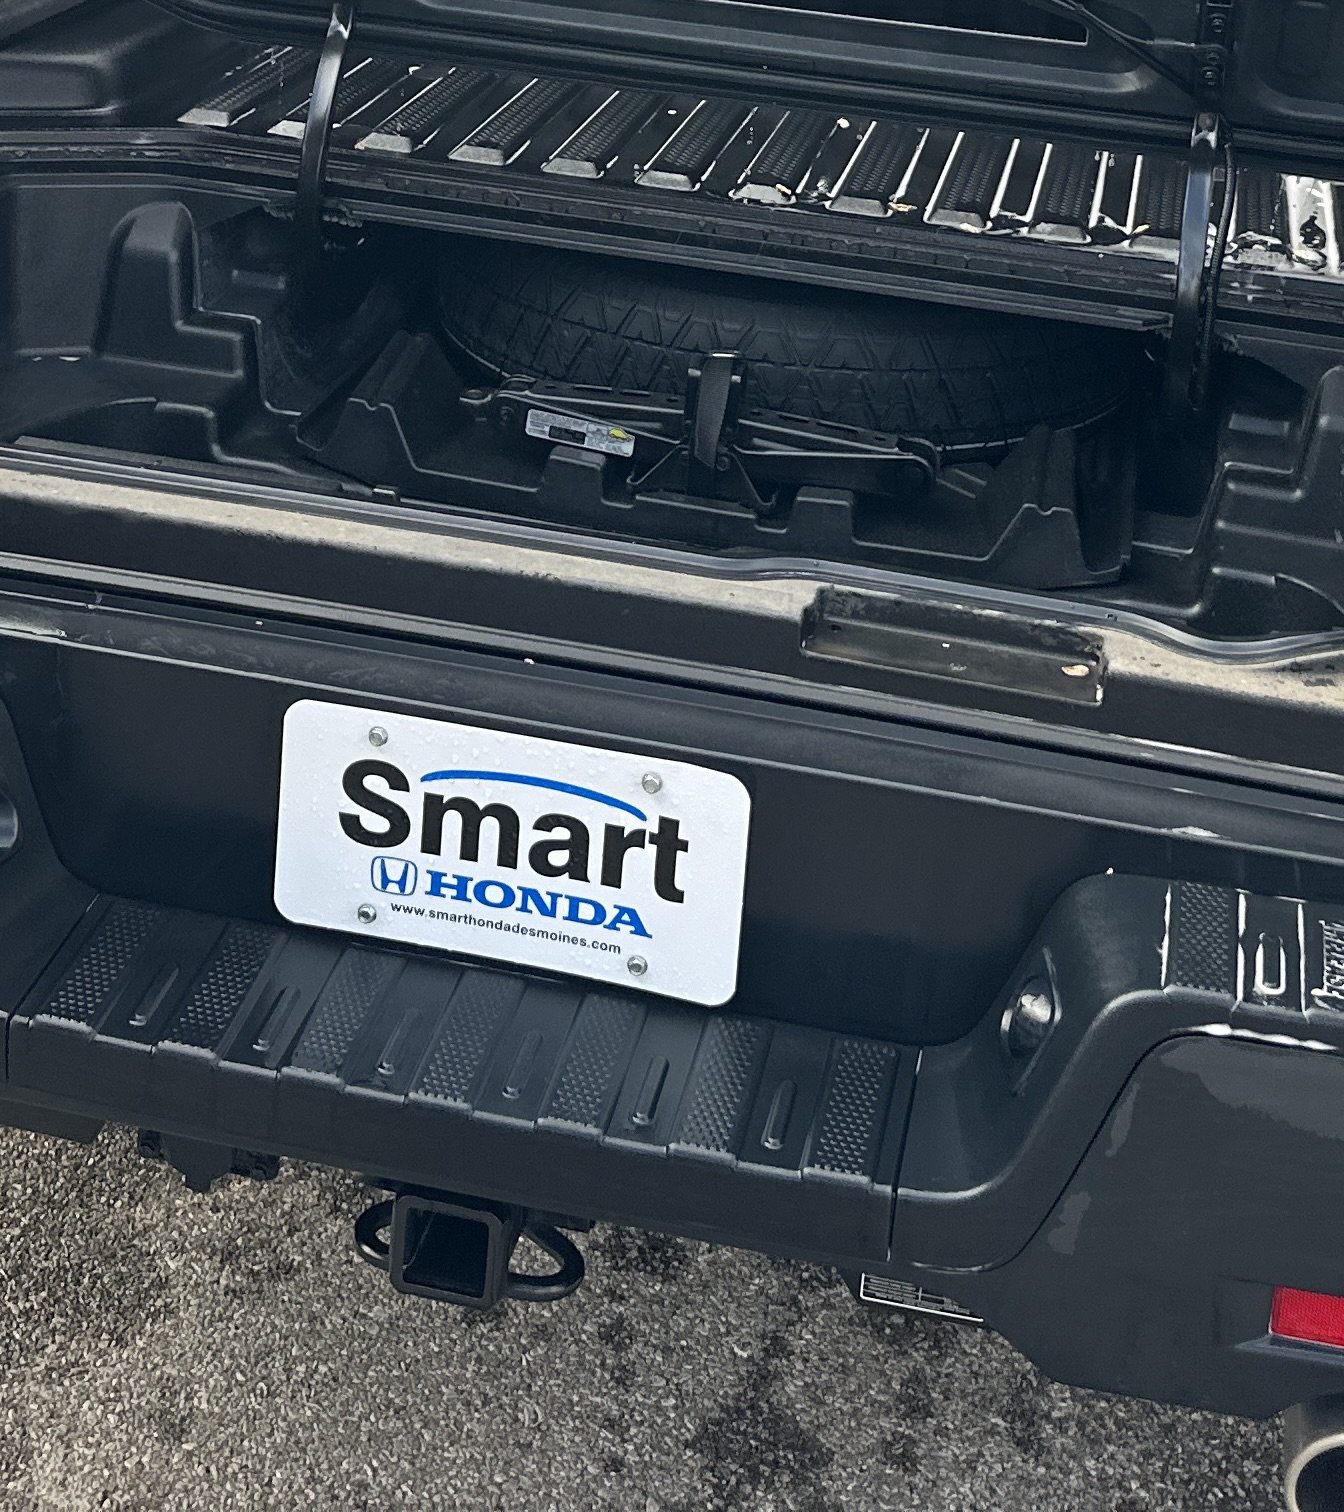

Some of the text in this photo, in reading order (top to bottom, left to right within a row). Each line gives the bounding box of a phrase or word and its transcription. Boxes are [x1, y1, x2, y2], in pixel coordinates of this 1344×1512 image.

[338, 758, 689, 904] Smart
[389, 902, 622, 955] www.smarthondadesmoines.com
[424, 869, 653, 939] HONDA
